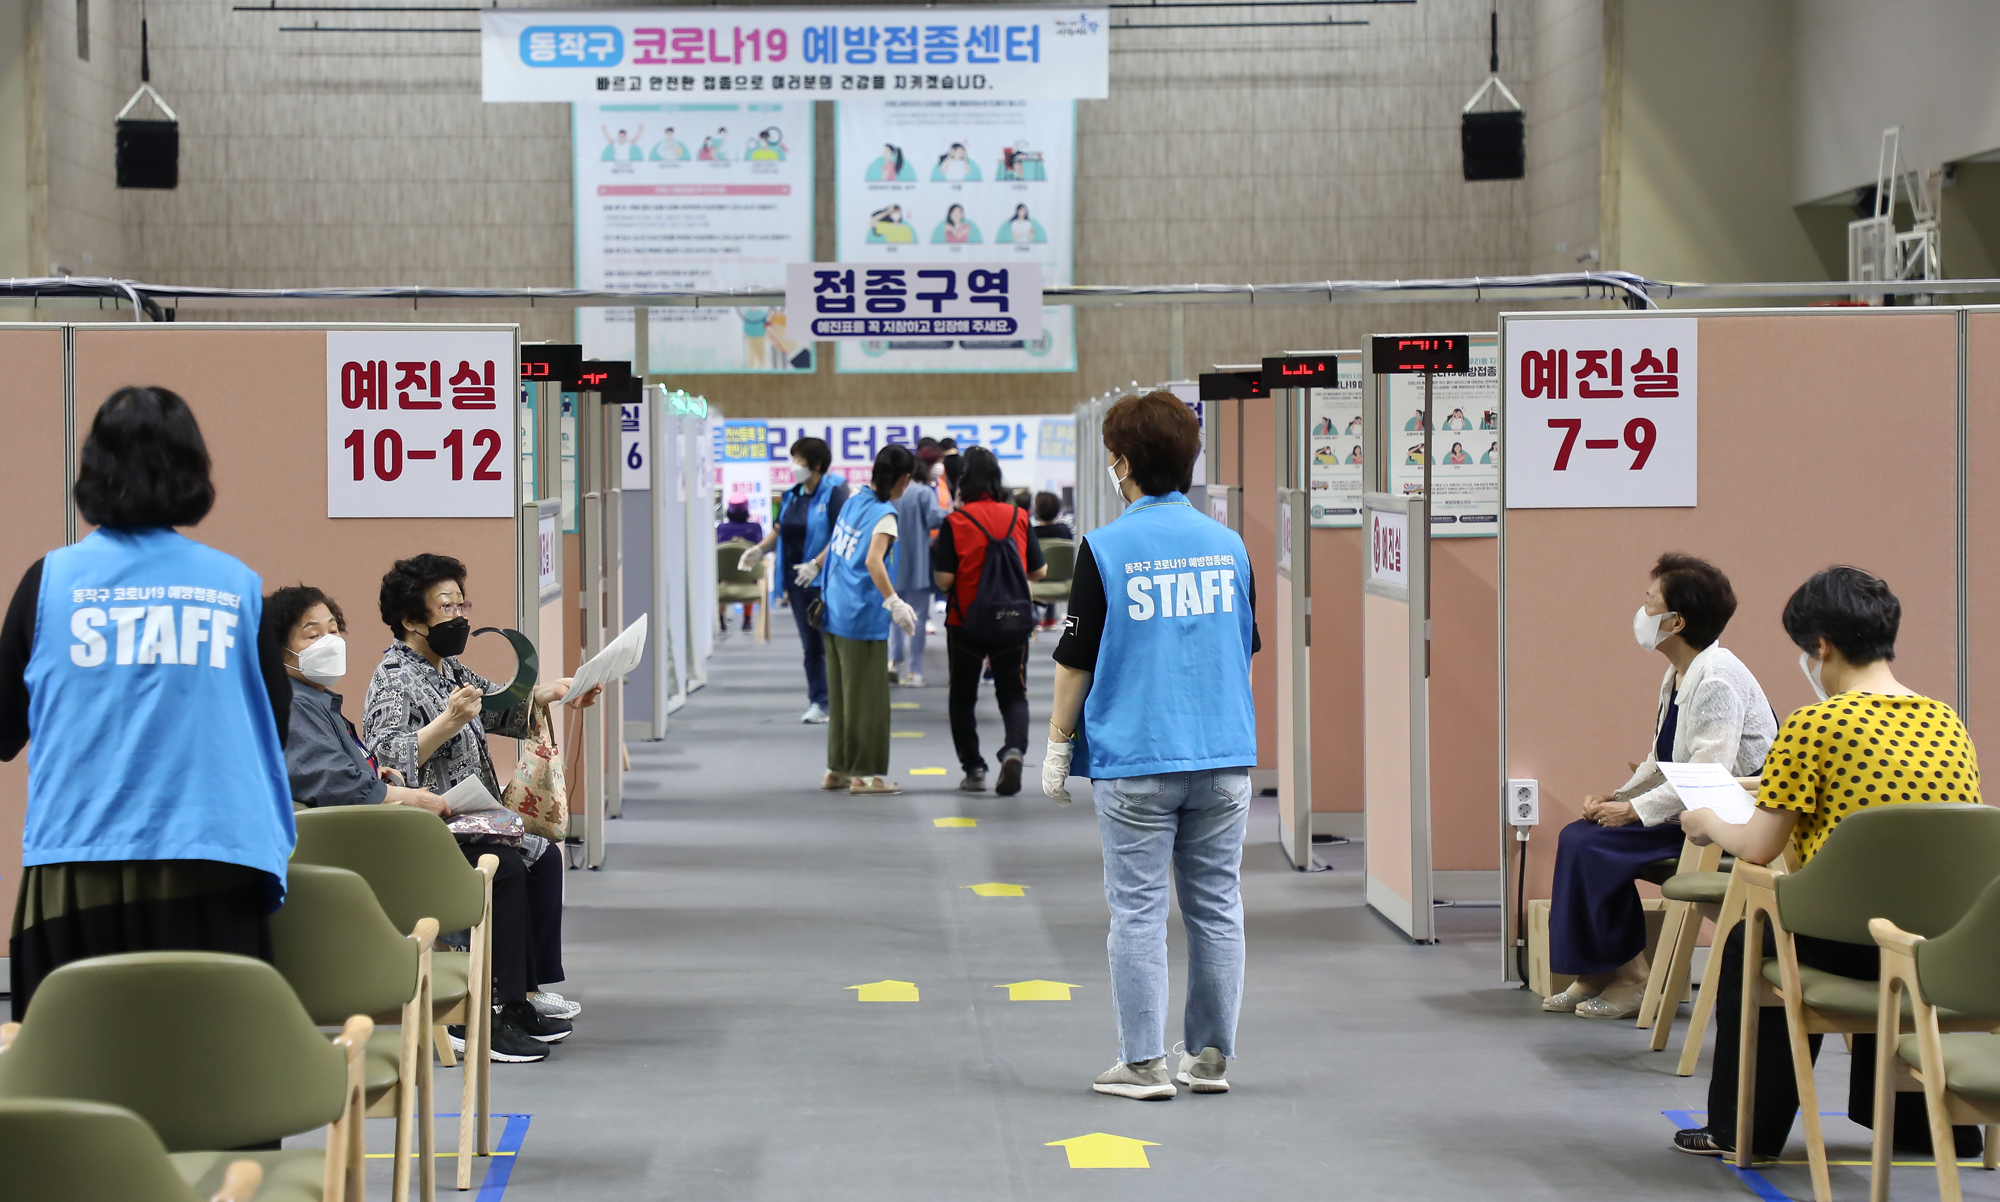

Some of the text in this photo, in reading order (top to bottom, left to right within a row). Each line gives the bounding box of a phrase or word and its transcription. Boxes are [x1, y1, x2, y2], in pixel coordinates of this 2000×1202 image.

[529, 32, 616, 62] 동작구
[632, 26, 788, 65] 코로나19
[803, 24, 1041, 64] 예방접종센터
[596, 75, 641, 91] 빠르고
[649, 75, 695, 91] 안전한
[703, 75, 763, 91] 접종으로
[772, 75, 832, 91] 여러분의
[841, 74, 885, 90] 건강을
[813, 268, 1010, 313] 접종구역
[817, 320, 865, 333] 예진표를
[867, 320, 880, 333] 꼭
[883, 320, 930, 333] 지참하고
[933, 320, 970, 333] 입장해
[340, 359, 498, 411] 예진실
[1520, 347, 1680, 400] 예진실
[343, 428, 503, 482] 10-12
[1547, 417, 1658, 471] 7-9
[1124, 555, 1234, 574] 동작구 코로나19 예방접종센터
[72, 586, 241, 609] 동작구 코로나19 예방접종센터
[1126, 569, 1235, 621] STAFF
[70, 605, 238, 669] STAFF
